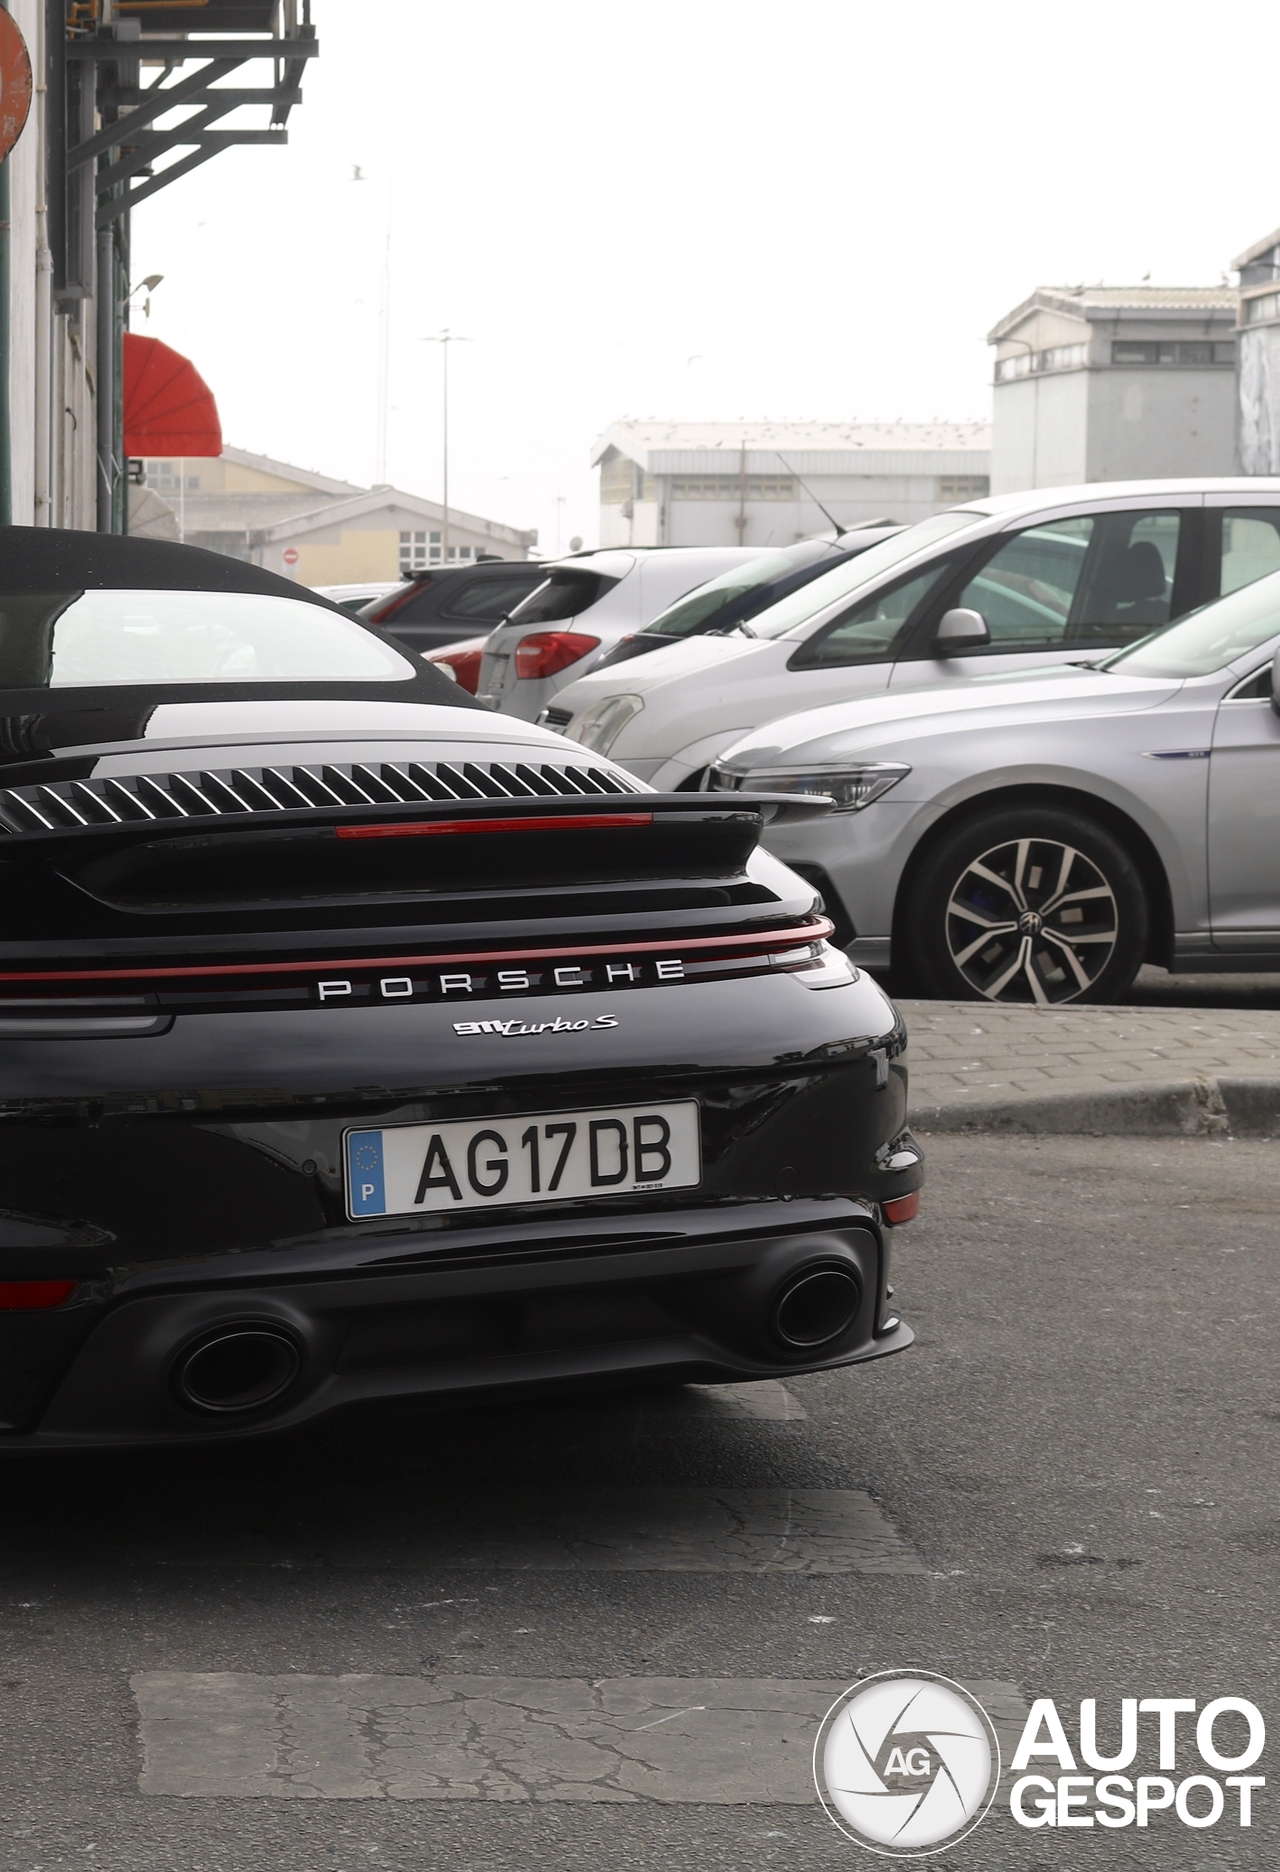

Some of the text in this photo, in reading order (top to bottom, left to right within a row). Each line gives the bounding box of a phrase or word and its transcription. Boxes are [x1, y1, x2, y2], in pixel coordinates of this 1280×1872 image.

[317, 959, 686, 1001] PORSCHE
[590, 1014, 620, 1031] S
[361, 1183, 375, 1201] P
